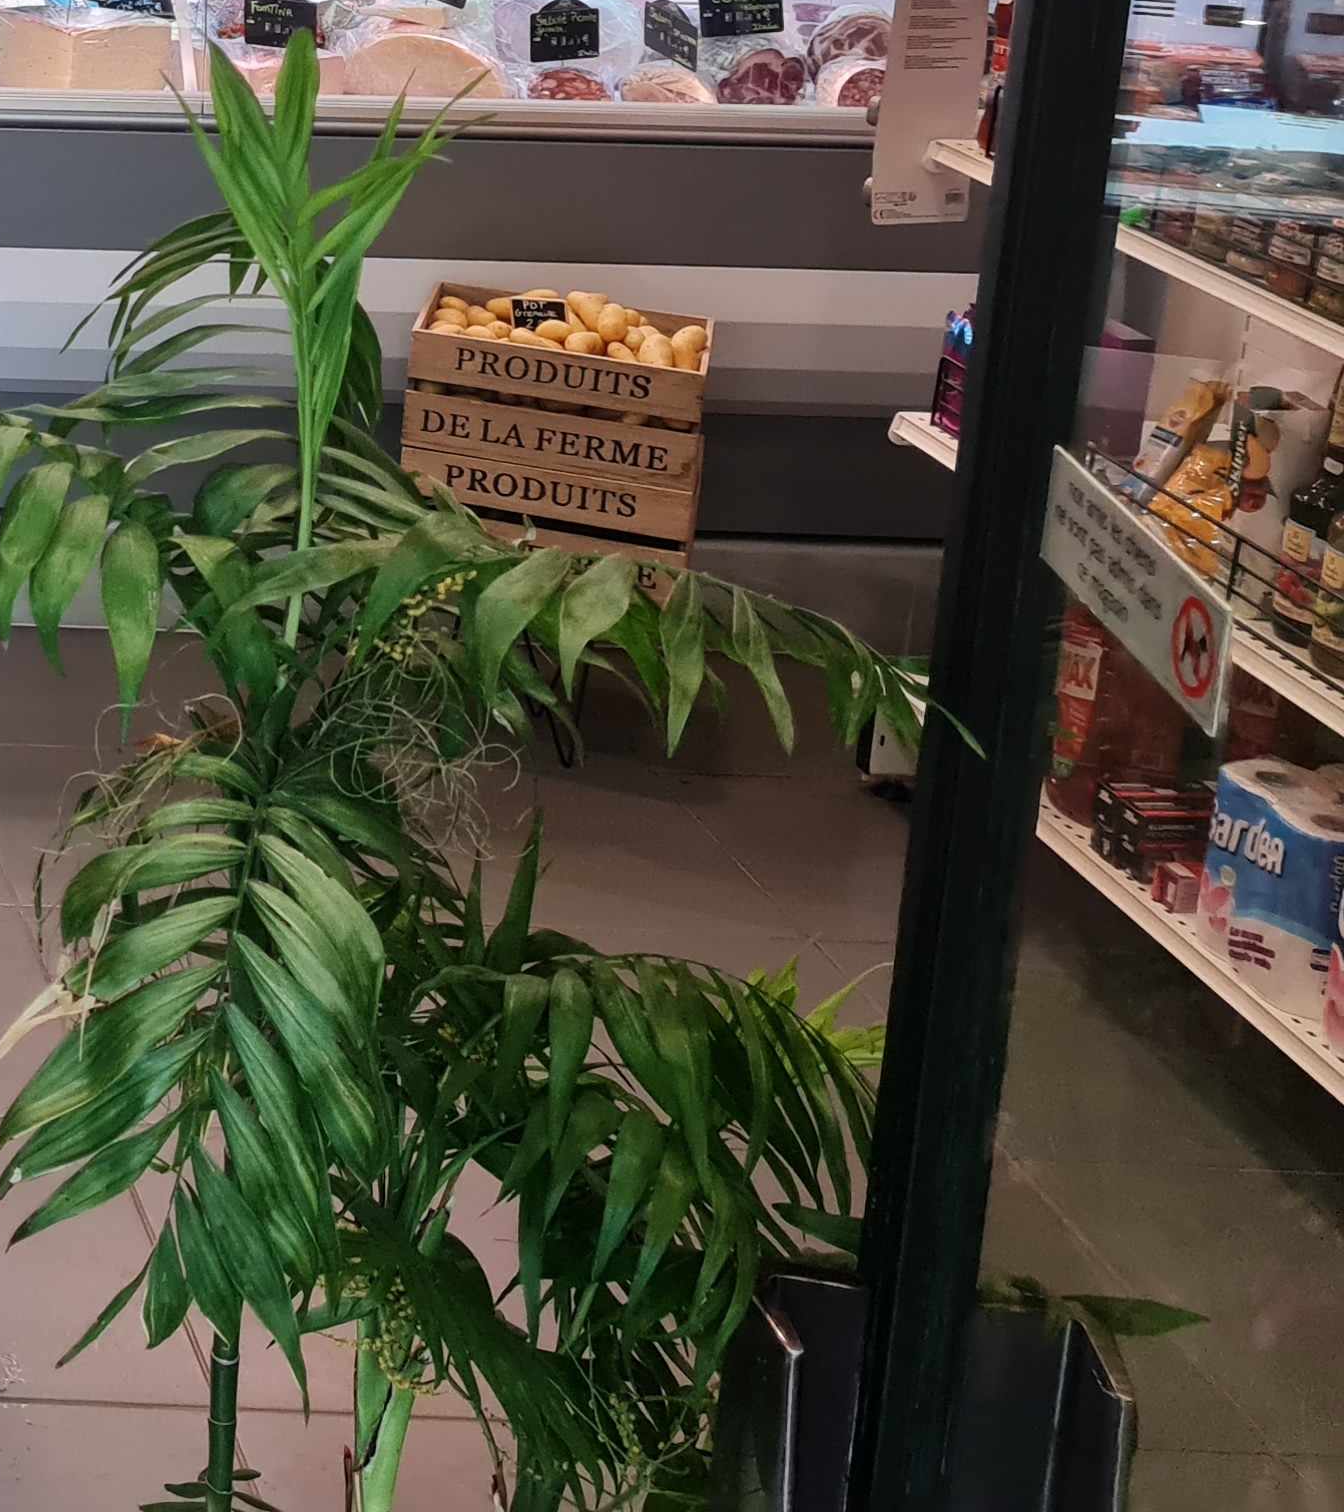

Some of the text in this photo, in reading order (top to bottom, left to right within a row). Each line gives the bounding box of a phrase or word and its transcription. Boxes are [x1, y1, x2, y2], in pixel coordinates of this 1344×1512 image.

[453, 345, 654, 401] PRODUITS
[419, 407, 671, 474] DE LA FERME
[1225, 419, 1251, 498] Skipper
[444, 462, 638, 519] PRODUITS
[1210, 805, 1286, 876] arden
